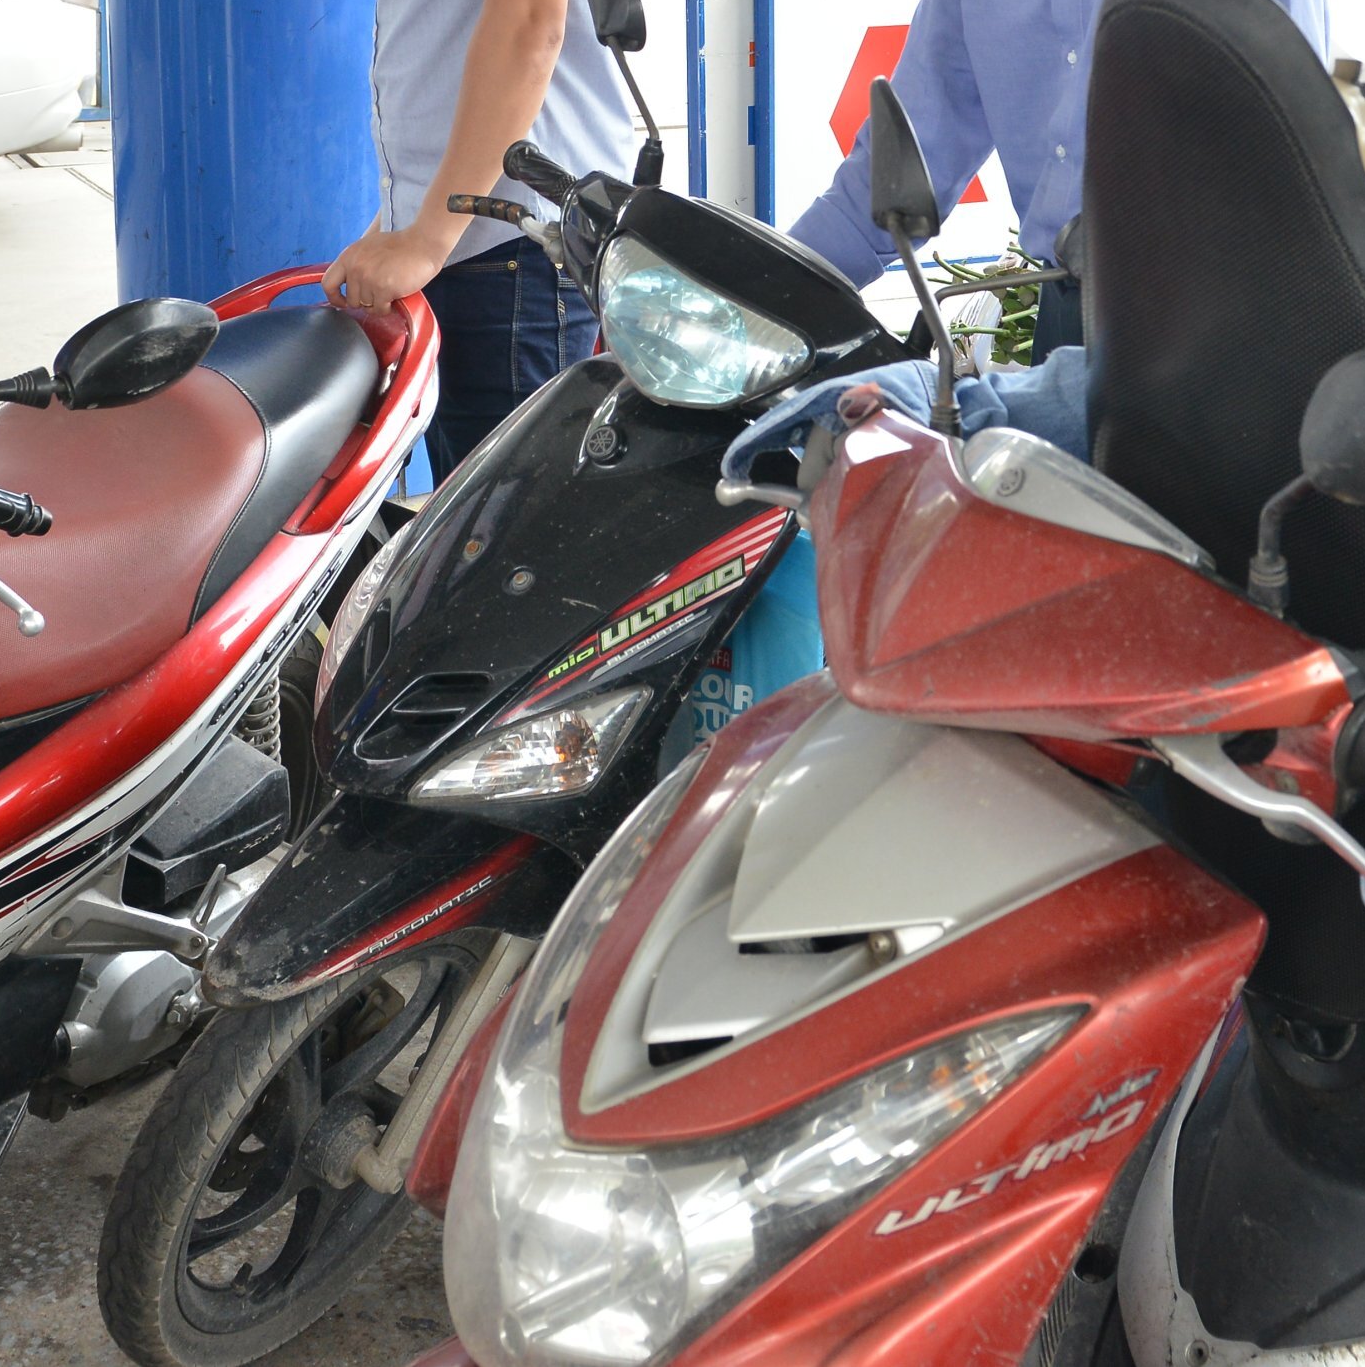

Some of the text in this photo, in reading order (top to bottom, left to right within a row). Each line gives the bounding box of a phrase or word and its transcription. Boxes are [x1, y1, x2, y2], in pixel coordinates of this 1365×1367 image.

[548, 556, 744, 679] mio ULTIMO
[606, 612, 696, 667] AUTOMATIC
[369, 875, 493, 954] AUTOMATIC
